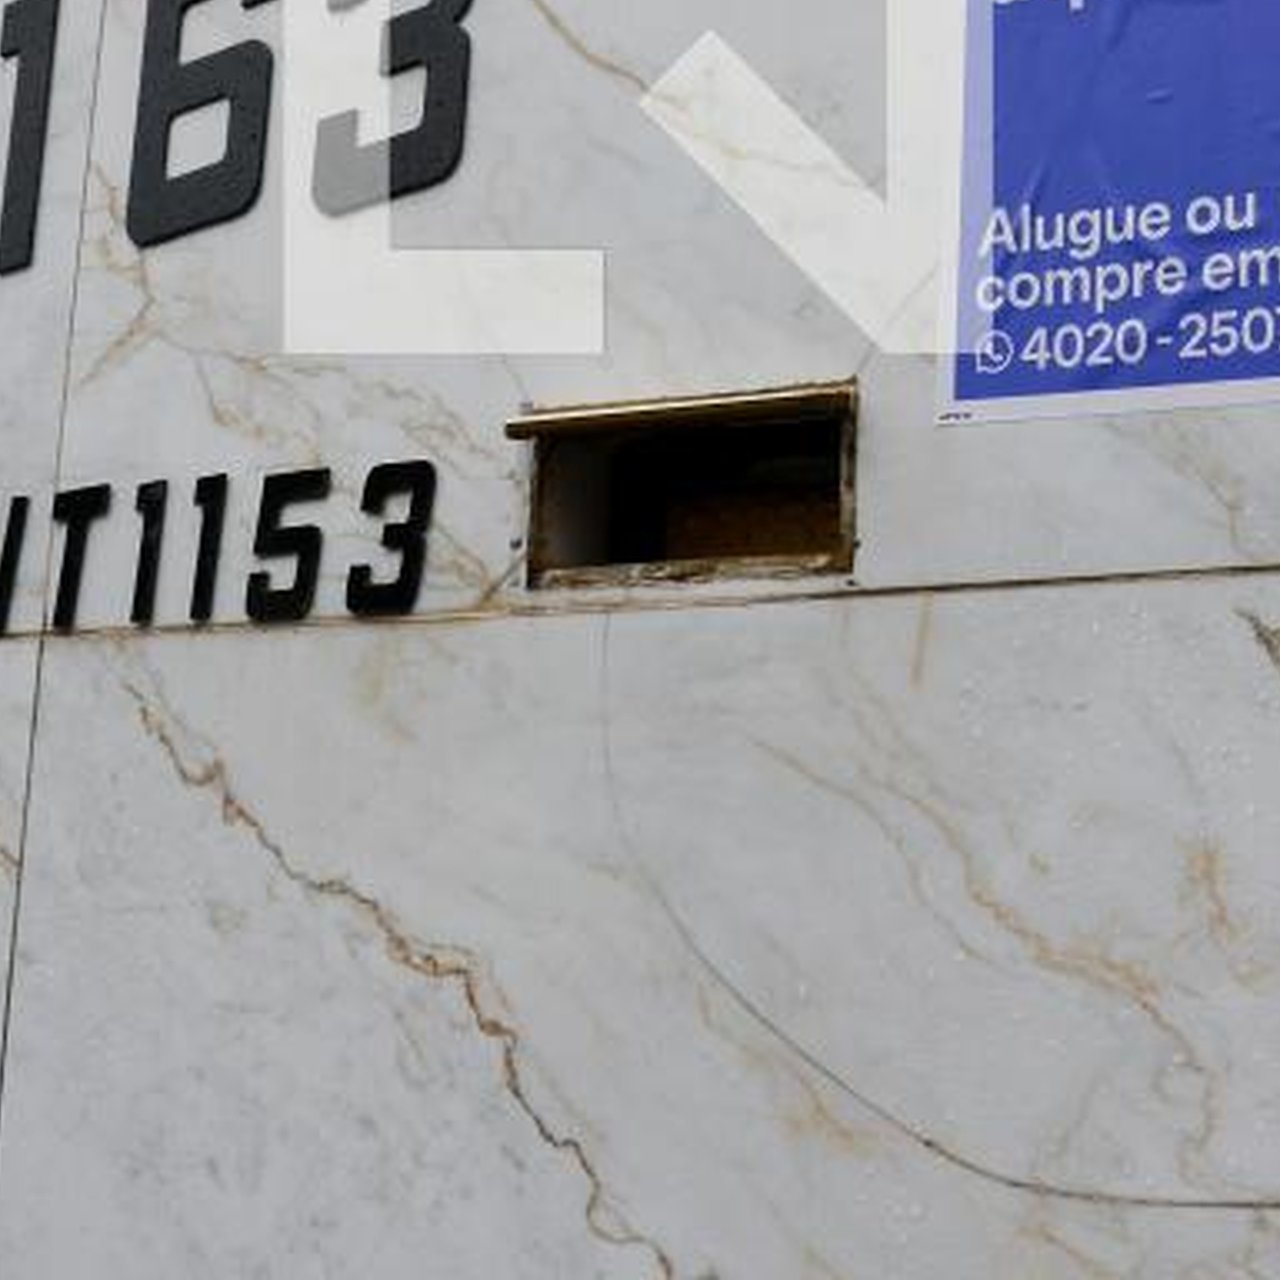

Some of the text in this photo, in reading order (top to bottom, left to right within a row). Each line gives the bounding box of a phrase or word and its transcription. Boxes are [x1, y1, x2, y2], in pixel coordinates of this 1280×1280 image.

[977, 191, 1257, 260] Alugue ou
[975, 253, 1188, 314] compre
